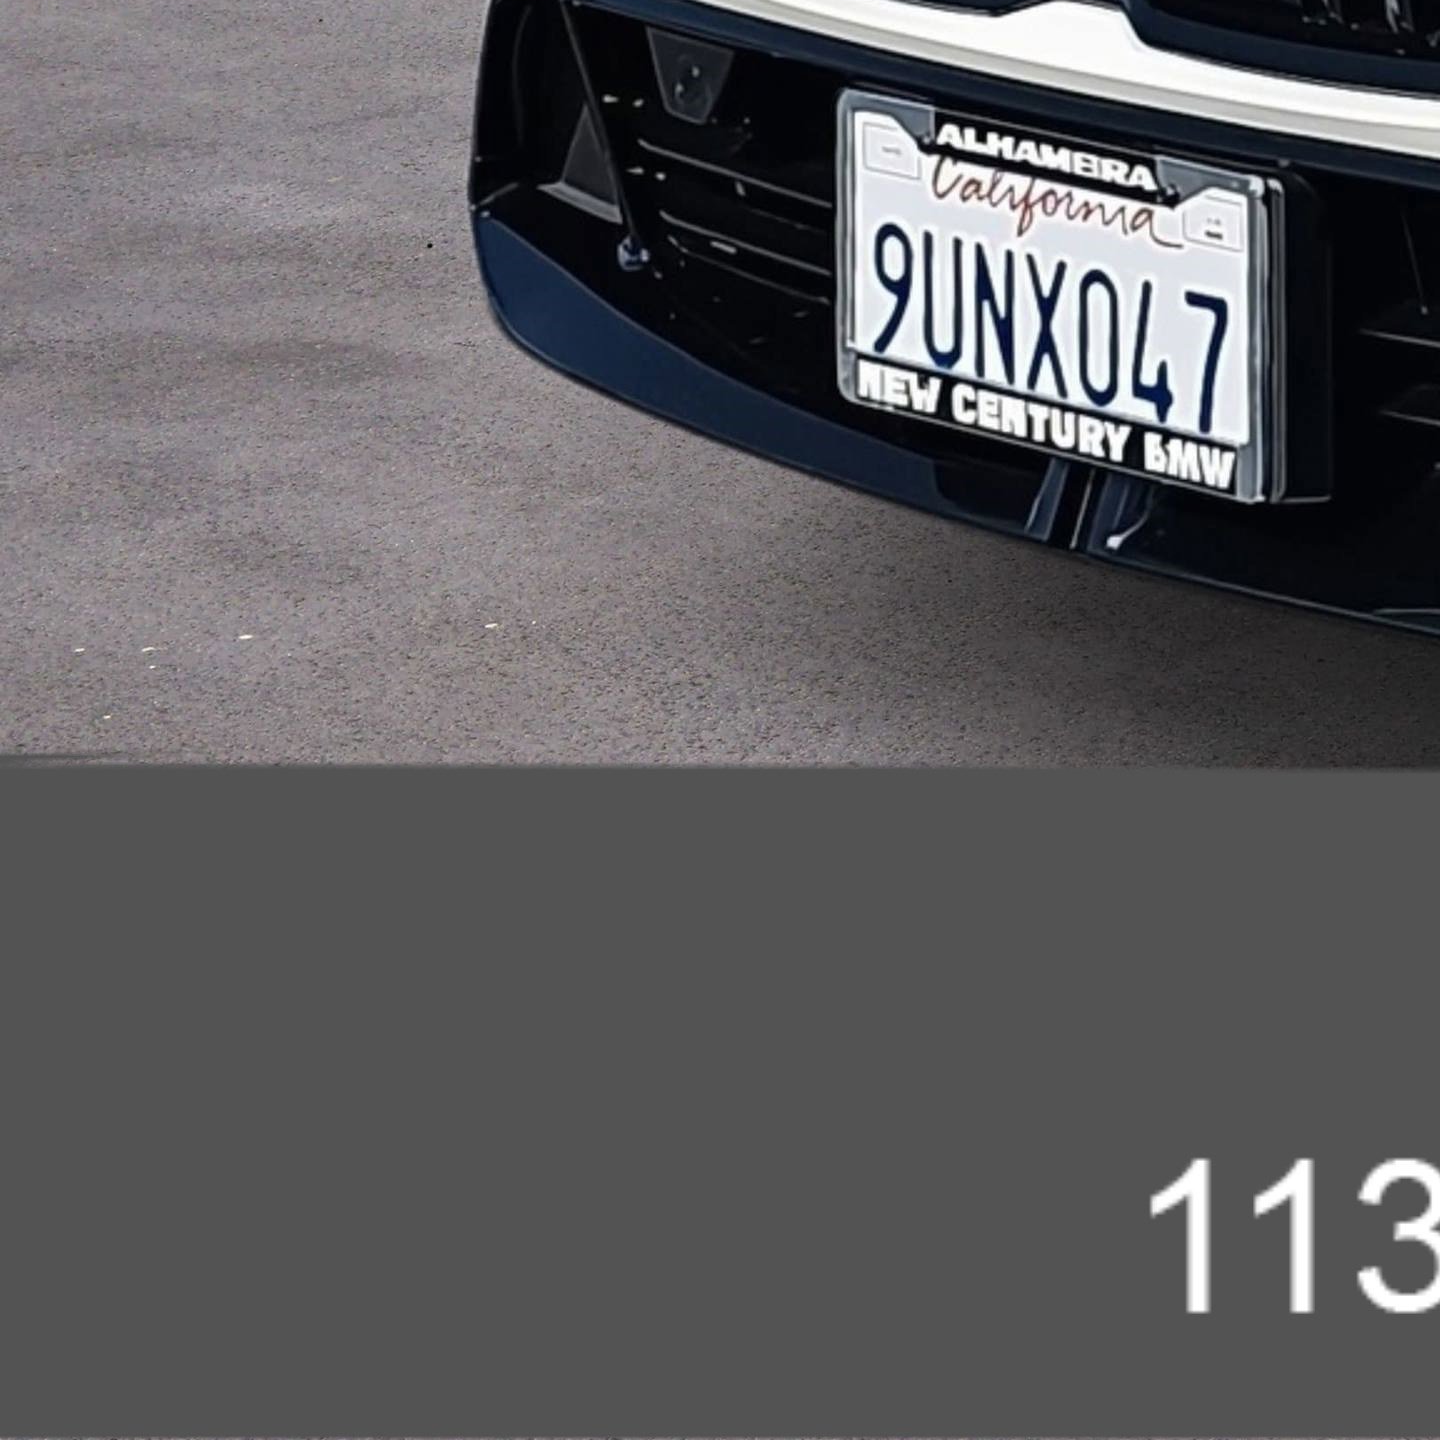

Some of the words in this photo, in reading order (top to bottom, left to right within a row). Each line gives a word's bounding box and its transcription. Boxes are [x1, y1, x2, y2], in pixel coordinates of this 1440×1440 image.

[931, 156, 1183, 248] California
[936, 123, 1158, 192] ALHAMBRA
[874, 222, 1229, 433] 9UNX047
[856, 359, 943, 414] NEW
[951, 382, 1134, 463] CENTURY
[1143, 431, 1236, 490] BMW
